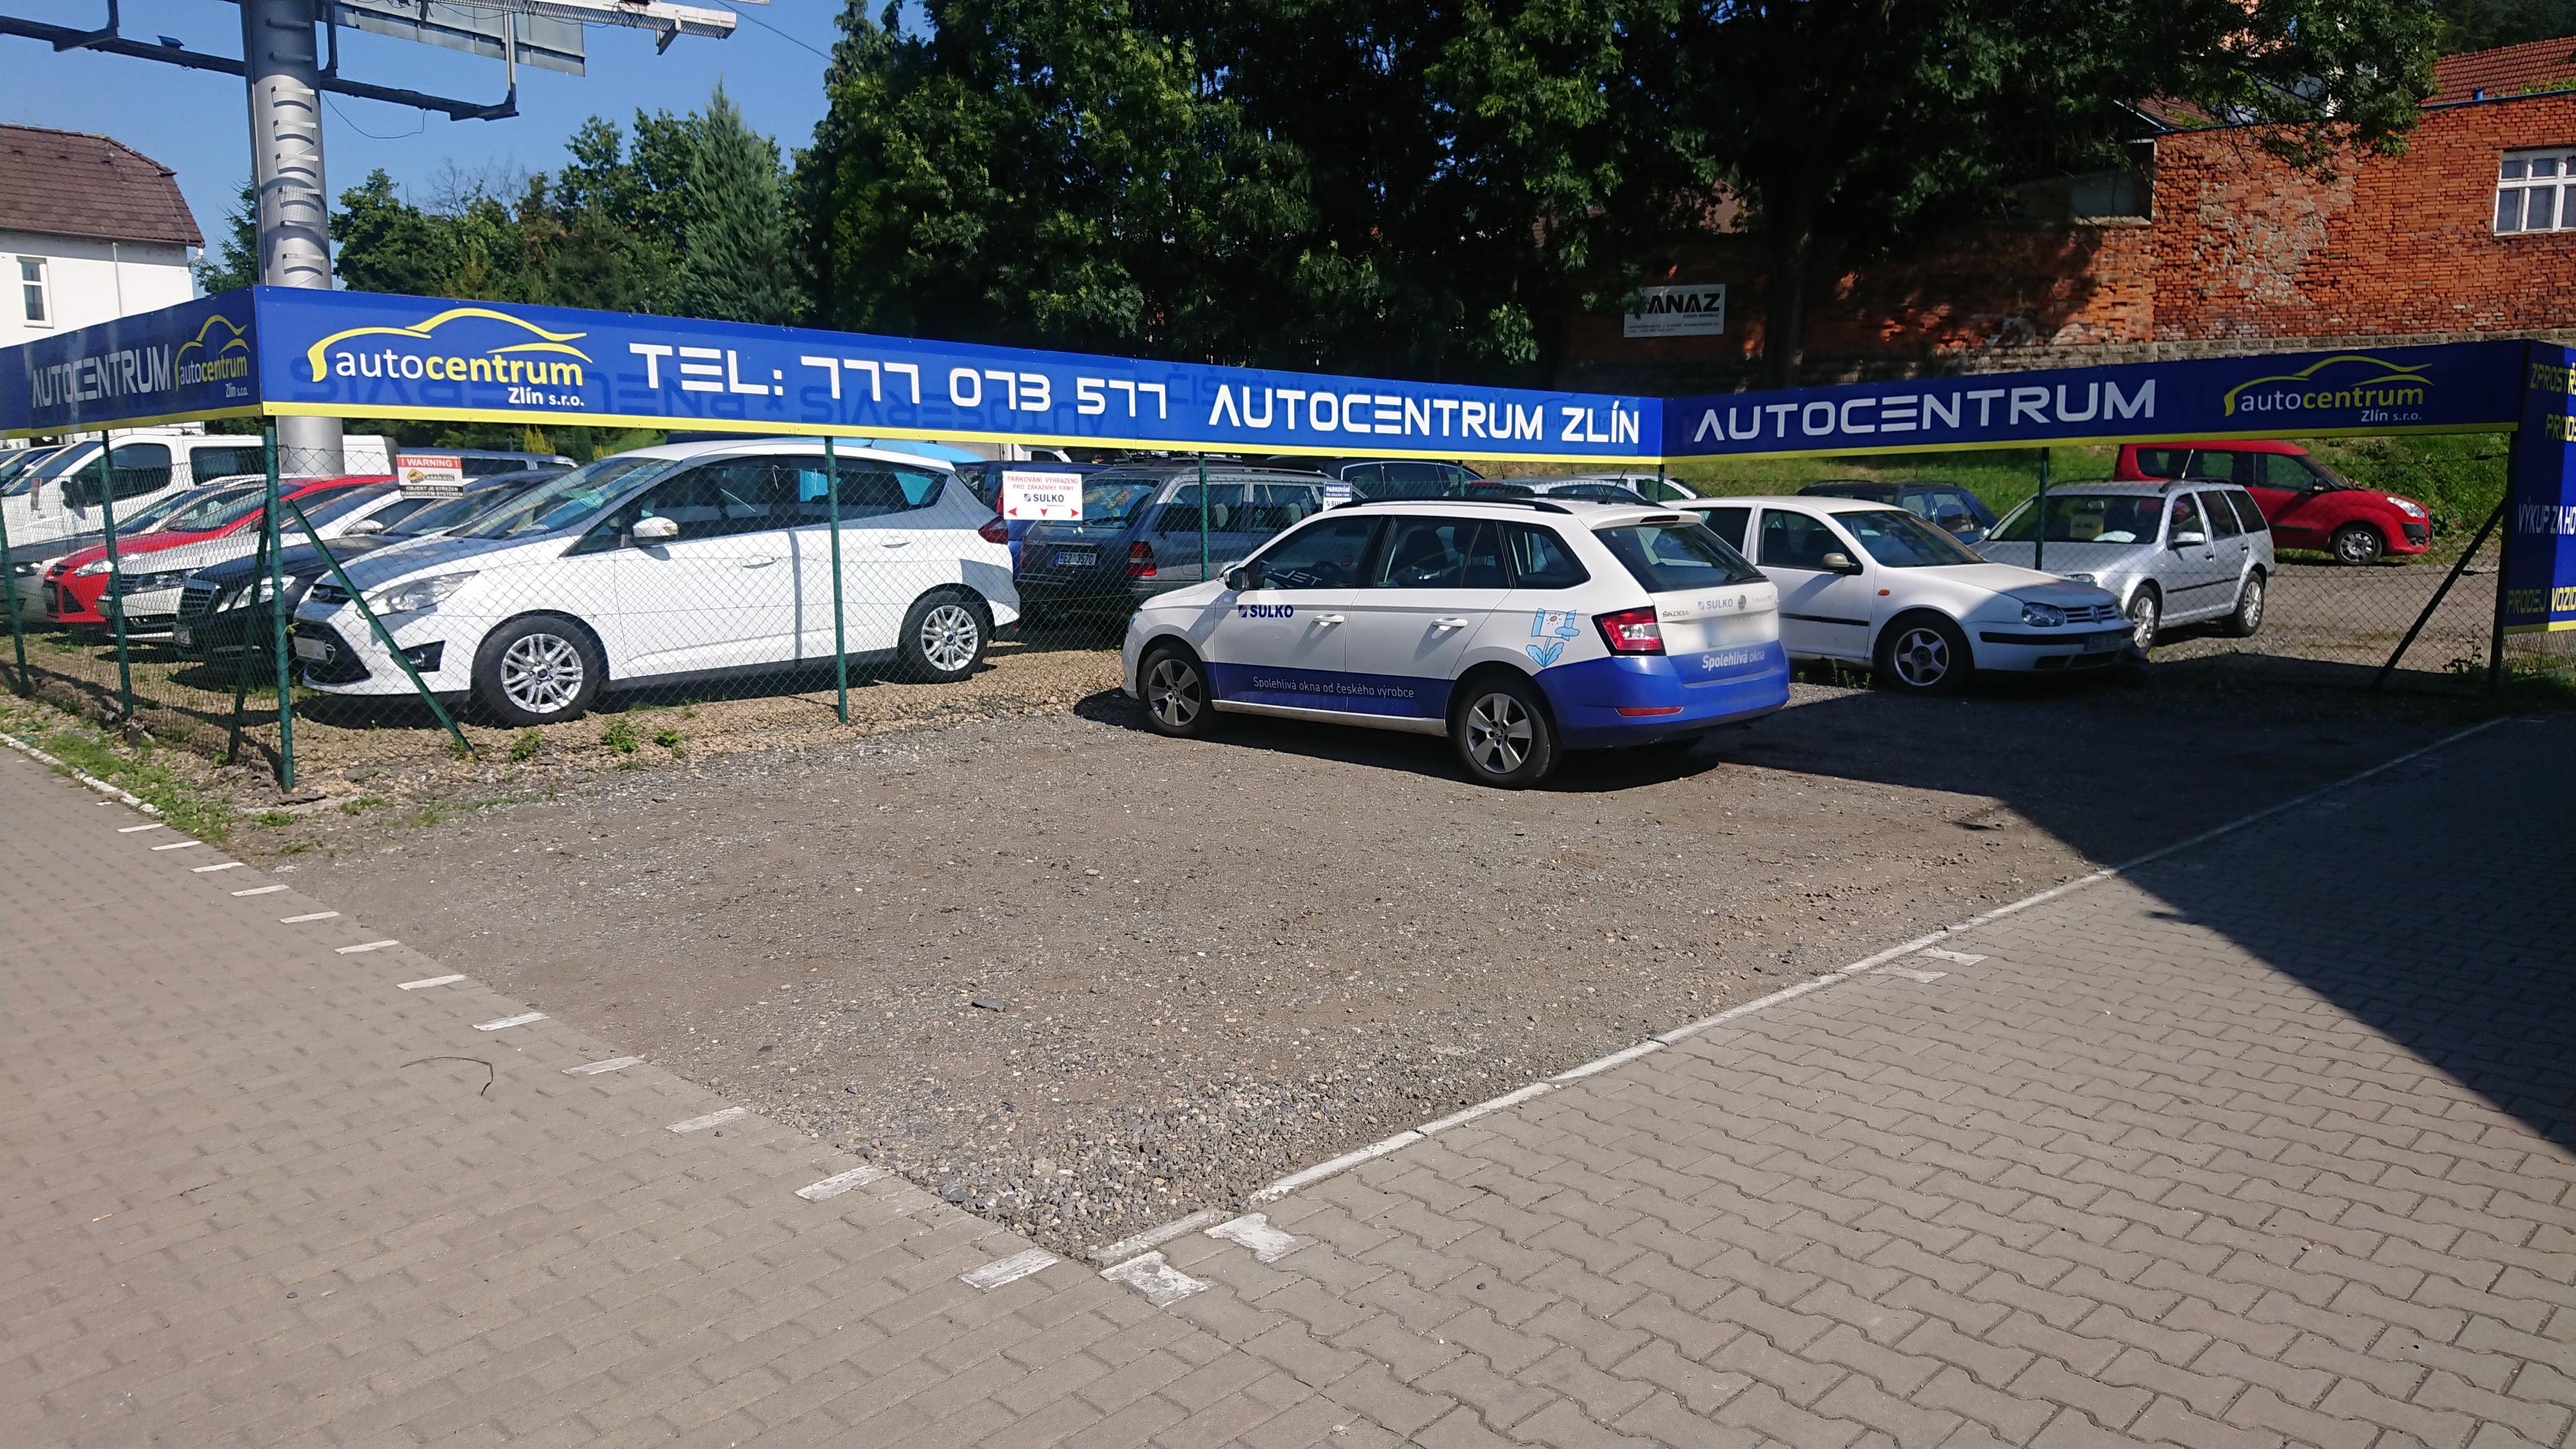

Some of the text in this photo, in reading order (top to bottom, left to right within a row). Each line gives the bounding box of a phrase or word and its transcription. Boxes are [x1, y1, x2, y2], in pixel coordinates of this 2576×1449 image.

[32, 344, 171, 408] AUTOCENTRUM
[179, 354, 248, 386] autocentrum
[336, 348, 583, 388] autocentrum
[225, 383, 249, 398] Zlín s.r.o.
[507, 386, 585, 406] Zlín s.r.o.
[629, 343, 784, 396] TEL:
[800, 355, 921, 404] 777
[949, 367, 1051, 412] 073
[1077, 376, 1167, 419] 577
[1208, 384, 1544, 440] AUTOCENTRUM
[1561, 400, 1639, 444] ZLÍN
[2240, 387, 2424, 412] autocentrum
[1693, 379, 2156, 443] AUTOCENTRUM
[2360, 409, 2422, 422] Zlín s.r.o.
[406, 458, 453, 468] WARNING
[1033, 493, 1065, 502] SULKO
[2518, 496, 2550, 535] VÝKUP
[1250, 604, 1294, 618] SULKO
[1707, 598, 1734, 609] SULKO
[2507, 587, 2548, 613] PRODEJ
[1662, 610, 1690, 618] ŠKODA
[1702, 649, 1765, 672] Spolehlivá okna
[1253, 676, 1414, 699] Spolehlivá okna od českého výrobce
